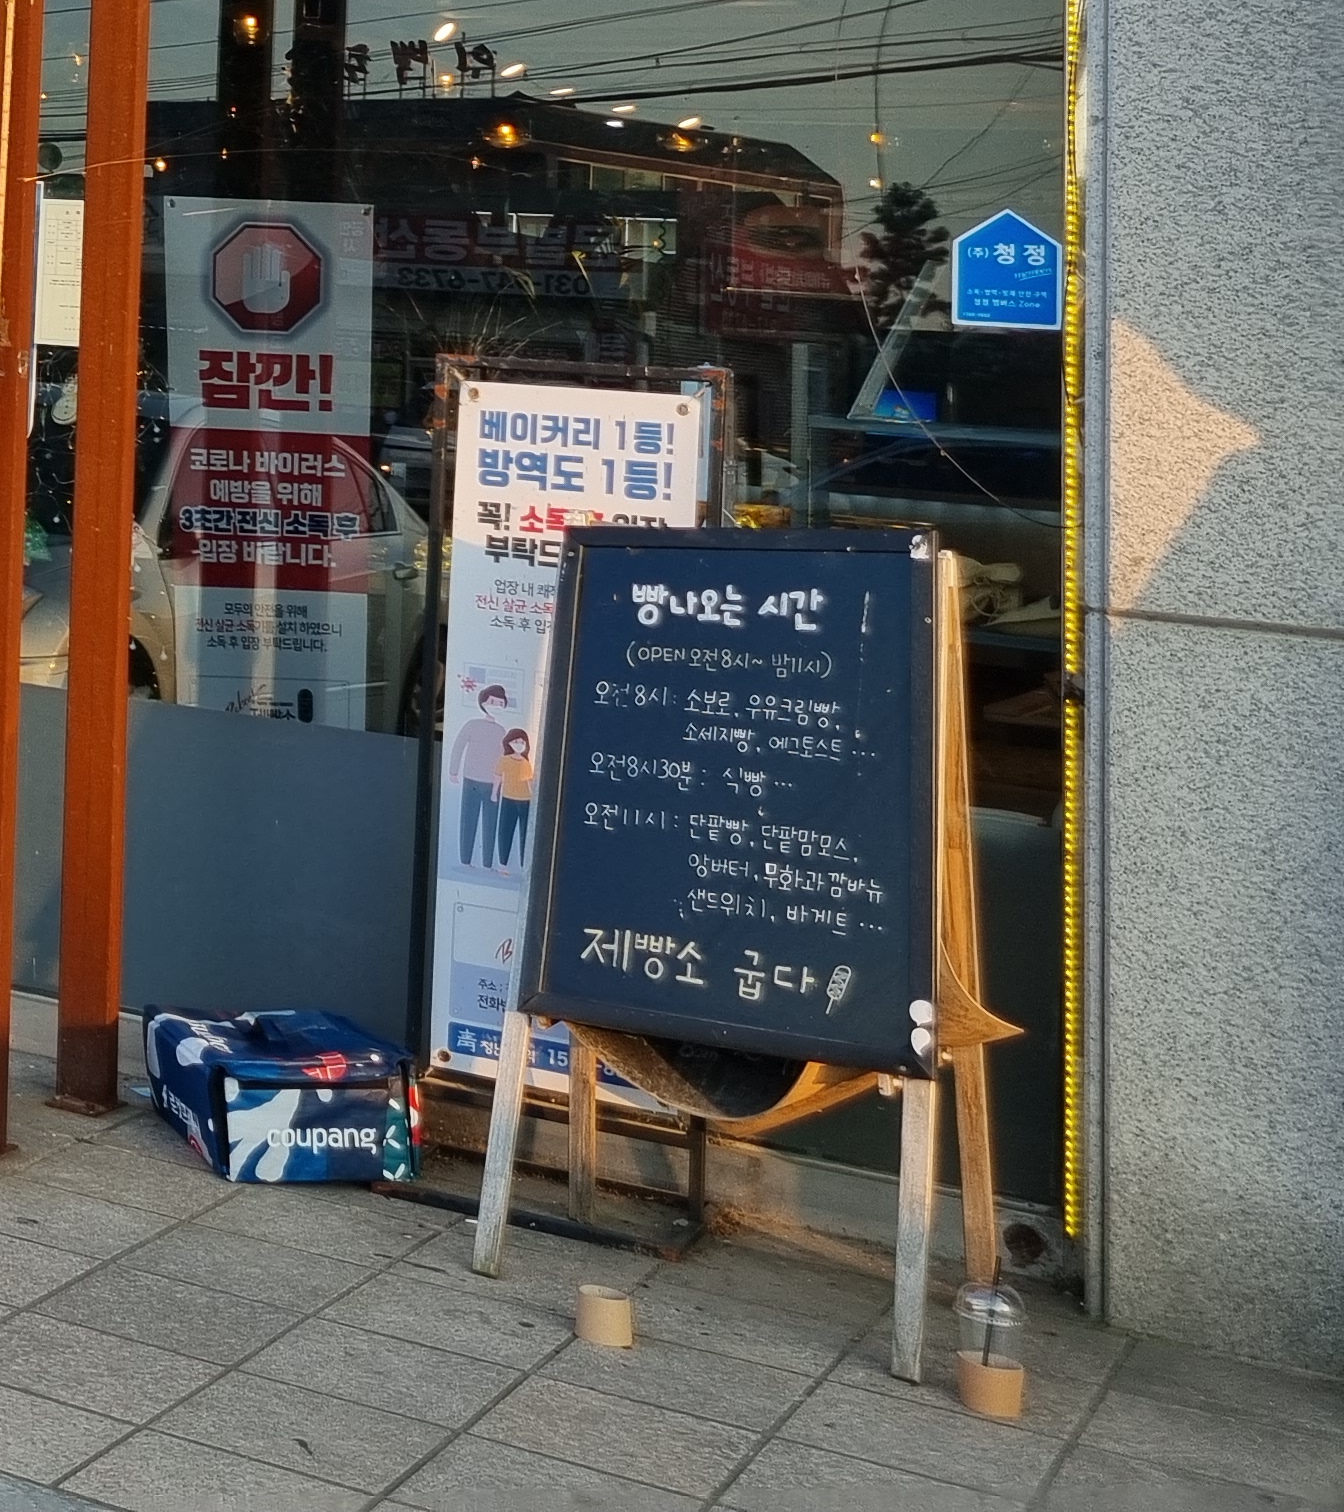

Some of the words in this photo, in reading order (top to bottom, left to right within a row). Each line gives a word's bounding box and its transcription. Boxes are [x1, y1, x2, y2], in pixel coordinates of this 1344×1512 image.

[967, 246, 989, 259] (주)
[198, 349, 334, 412] 잠깐!
[479, 409, 601, 451] 베이커리
[615, 419, 675, 456] 1등!
[189, 447, 251, 473] 코로나
[255, 450, 347, 478] 바이러스
[477, 448, 585, 493] 방역도
[601, 458, 673, 501] 1등!
[209, 479, 272, 505] 예방을
[276, 482, 323, 507] 위해
[179, 505, 235, 535] 3초간
[235, 507, 282, 536] 전신
[283, 510, 332, 540] 소독
[333, 513, 361, 541] 후
[477, 500, 512, 531] 꼭!
[197, 538, 239, 564] 입장
[242, 541, 338, 569] 바랍니다.
[494, 578, 520, 595] 업장
[521, 582, 535, 596] 내
[286, 605, 308, 619] 위해
[475, 594, 500, 611] 전신
[502, 597, 528, 614] 살균
[632, 584, 743, 627] 빵나오는
[758, 588, 824, 631] 시간
[490, 615, 517, 631] 소독
[518, 616, 531, 633] 후
[722, 766, 767, 797] 식빵
[762, 862, 825, 891] 무화과
[786, 904, 848, 936] 바게트
[579, 927, 706, 986] 제빵소
[733, 948, 817, 1001] 굽다
[267, 1127, 377, 1156] coupang
